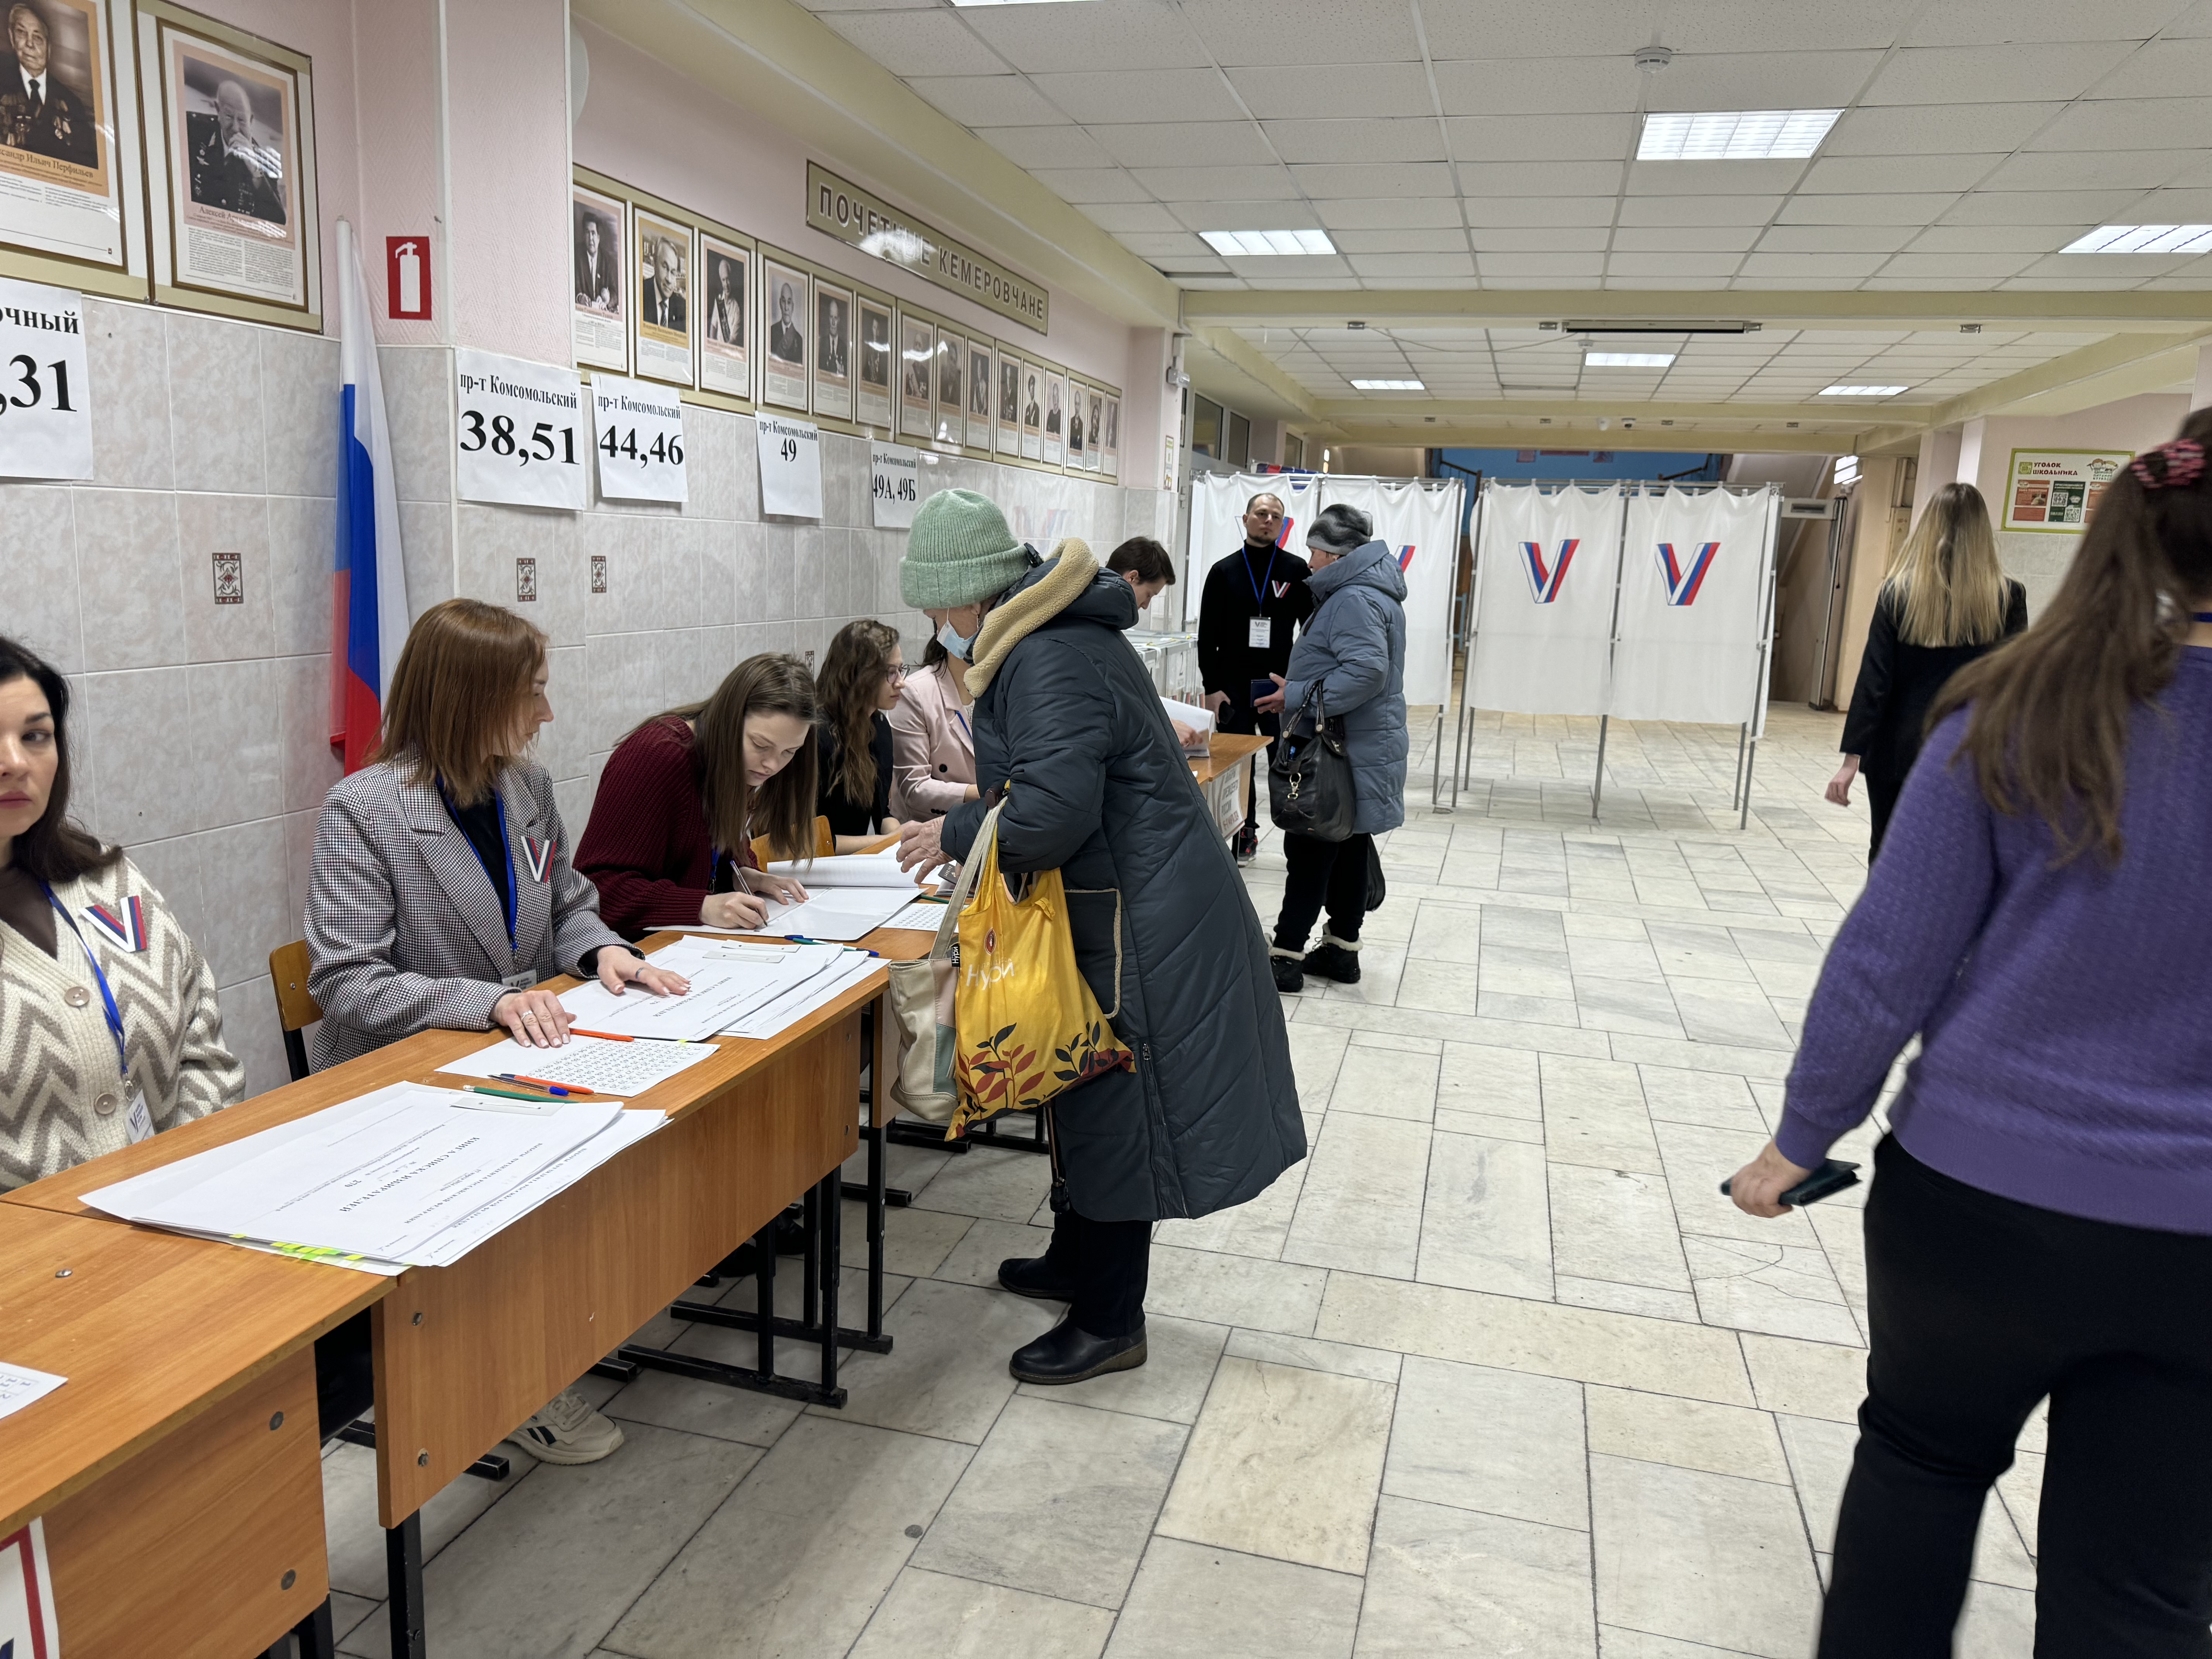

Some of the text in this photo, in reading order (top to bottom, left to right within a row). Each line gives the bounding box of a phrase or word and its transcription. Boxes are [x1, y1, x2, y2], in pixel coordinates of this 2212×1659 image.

[26, 153, 51, 167] Ильич
[53, 161, 93, 178] Перфильев
[819, 182, 1044, 320] ПОЧЕТЕ КЕМЕРОВЧАНЕ
[0, 307, 79, 335] чный
[460, 374, 577, 409] пр-т Комсомольский
[598, 395, 681, 419] пр-т Комсомольский
[460, 410, 580, 467] 38,51
[759, 421, 818, 441] пр-т Комсомольский
[599, 425, 684, 469] 44,46
[781, 438, 797, 462] 49
[873, 453, 916, 468] пр-т Комсомольский
[873, 474, 916, 505] 49А, 49Б
[951, 946, 960, 963] Нури
[966, 961, 1015, 991] Нури
[447, 1137, 480, 1154] КНИГА
[409, 1154, 450, 1174] СПИСКА
[339, 1175, 412, 1212] ИЗБИРАТЕЛЕЙ
